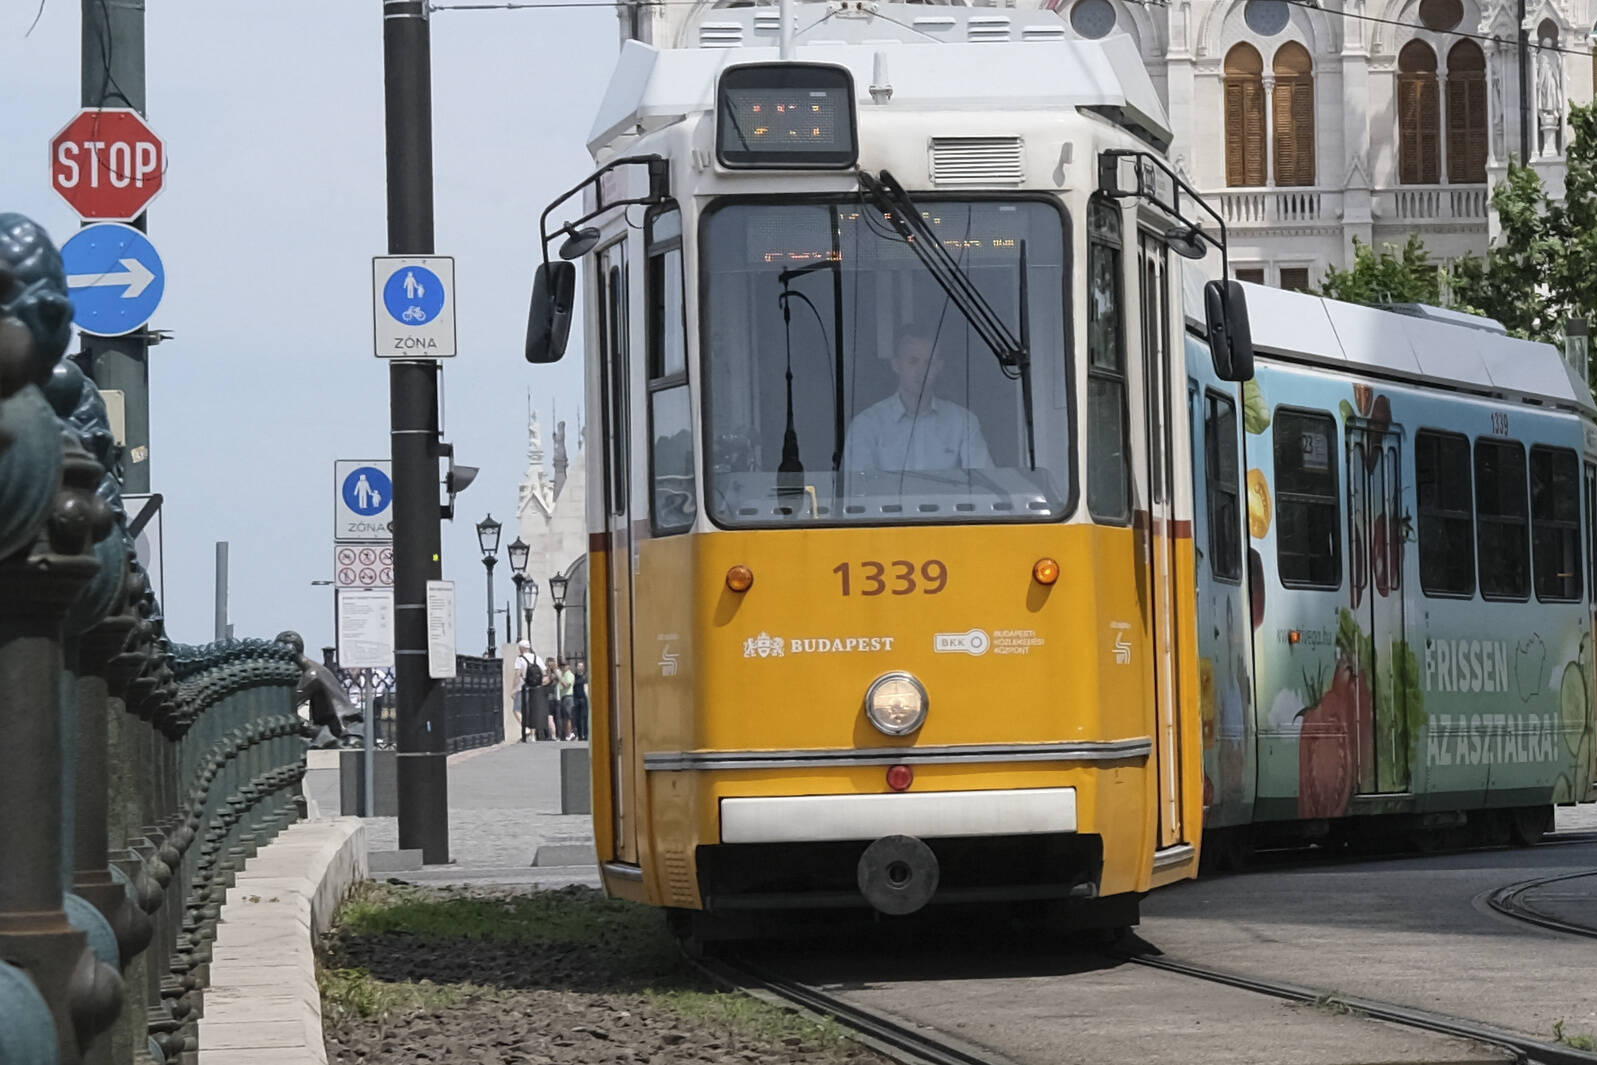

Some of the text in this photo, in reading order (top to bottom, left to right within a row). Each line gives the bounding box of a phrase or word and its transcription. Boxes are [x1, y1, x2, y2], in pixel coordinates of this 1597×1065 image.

[57, 141, 157, 188] STOP
[394, 335, 437, 349] ZÓNA
[1490, 412, 1509, 436] 1339
[347, 520, 386, 533] ZÓNA
[832, 559, 949, 597] 1339
[790, 637, 894, 653] BUDAPEST
[941, 638, 966, 647] BKK
[1425, 639, 1509, 693] FRISSEN
[1427, 711, 1559, 767] AZ ASZTALRA!
